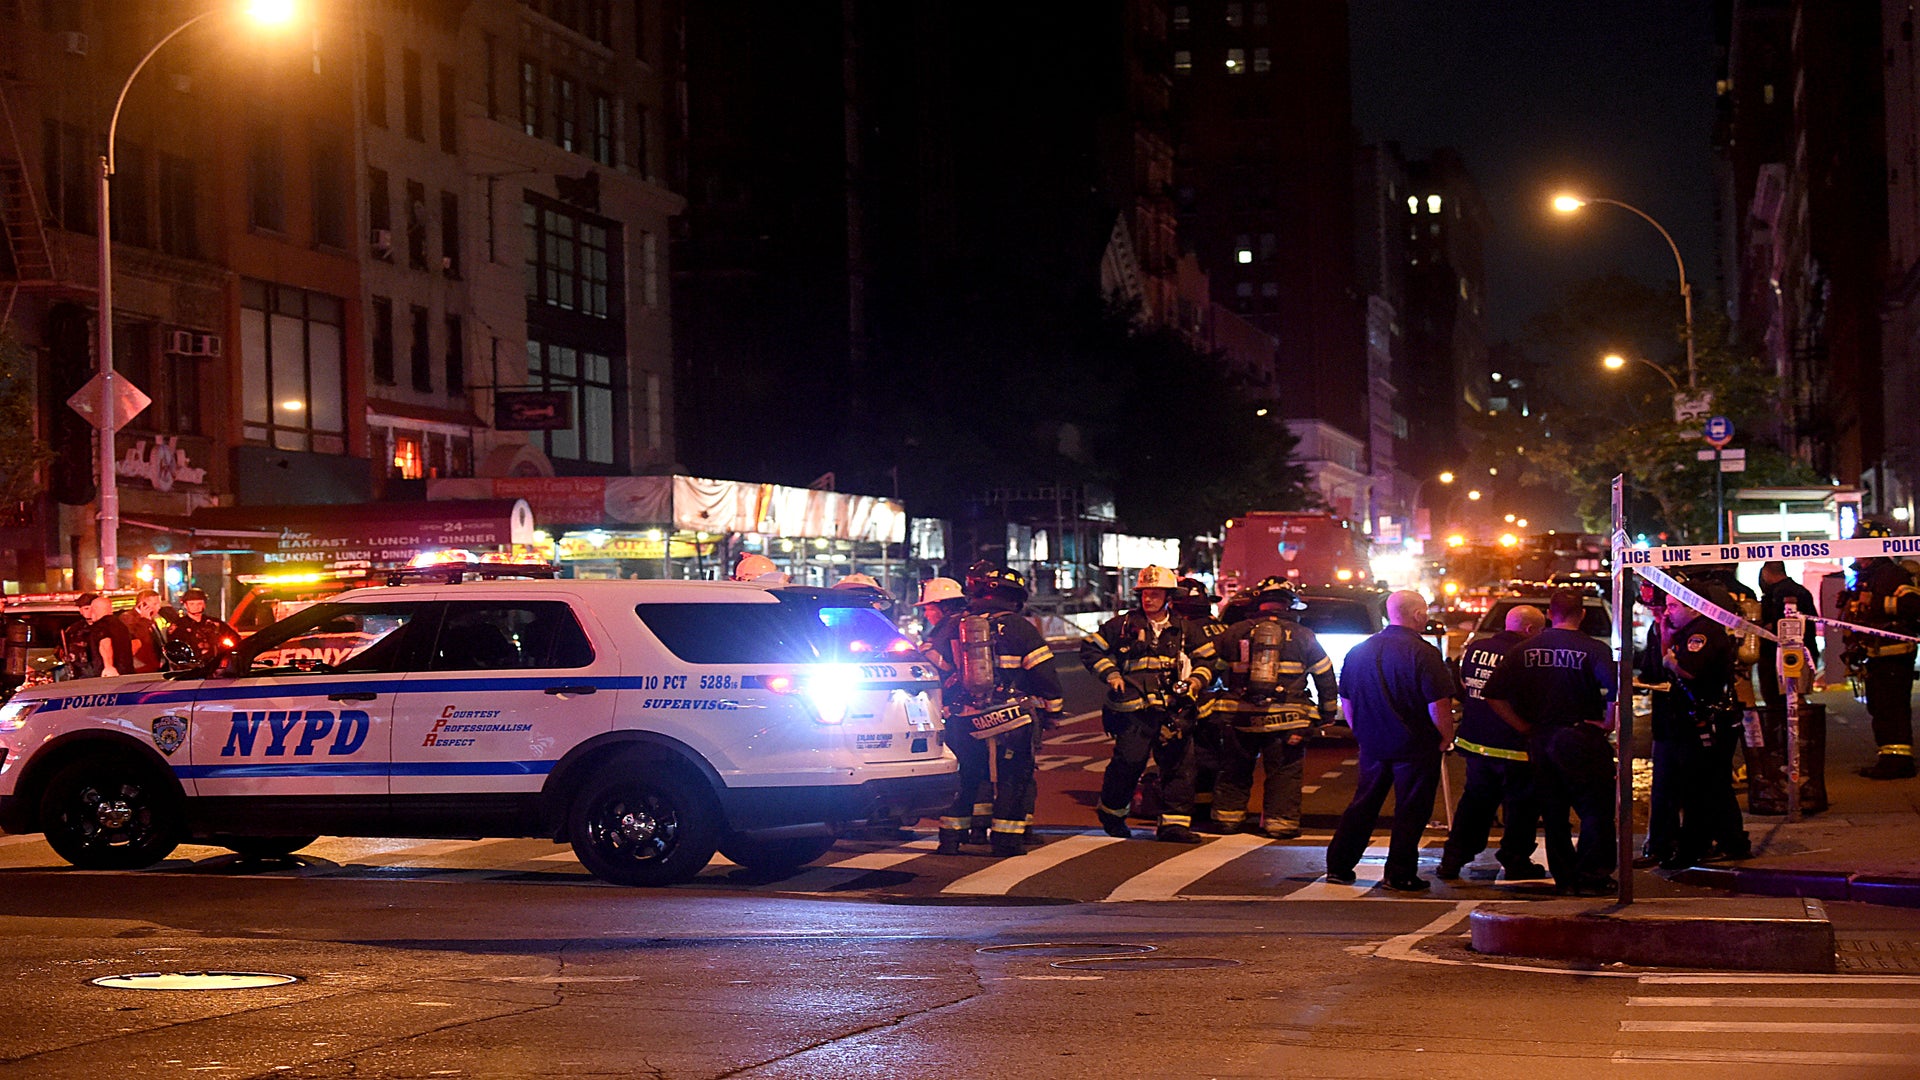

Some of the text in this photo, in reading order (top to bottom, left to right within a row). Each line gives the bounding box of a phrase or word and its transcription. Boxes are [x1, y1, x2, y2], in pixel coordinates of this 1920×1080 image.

[444, 522, 462, 532] 24
[369, 537, 419, 545] LUNCH
[438, 534, 496, 544] DINNER
[264, 552, 325, 563] BREAKFAST
[336, 551, 371, 560] LUNCH
[1662, 549, 1691, 562] LINE
[1720, 547, 1739, 559] DO
[1747, 545, 1774, 559] NOT
[1781, 543, 1829, 557] CROSS
[1882, 539, 1920, 553] POLIC
[1524, 648, 1587, 669] FDNY
[860, 665, 897, 678] NYPD
[645, 675, 659, 690] 10
[663, 675, 687, 689] PCT
[62, 694, 118, 710] POLICE
[972, 705, 1020, 729] BARRETT
[220, 709, 370, 757] NYPD
